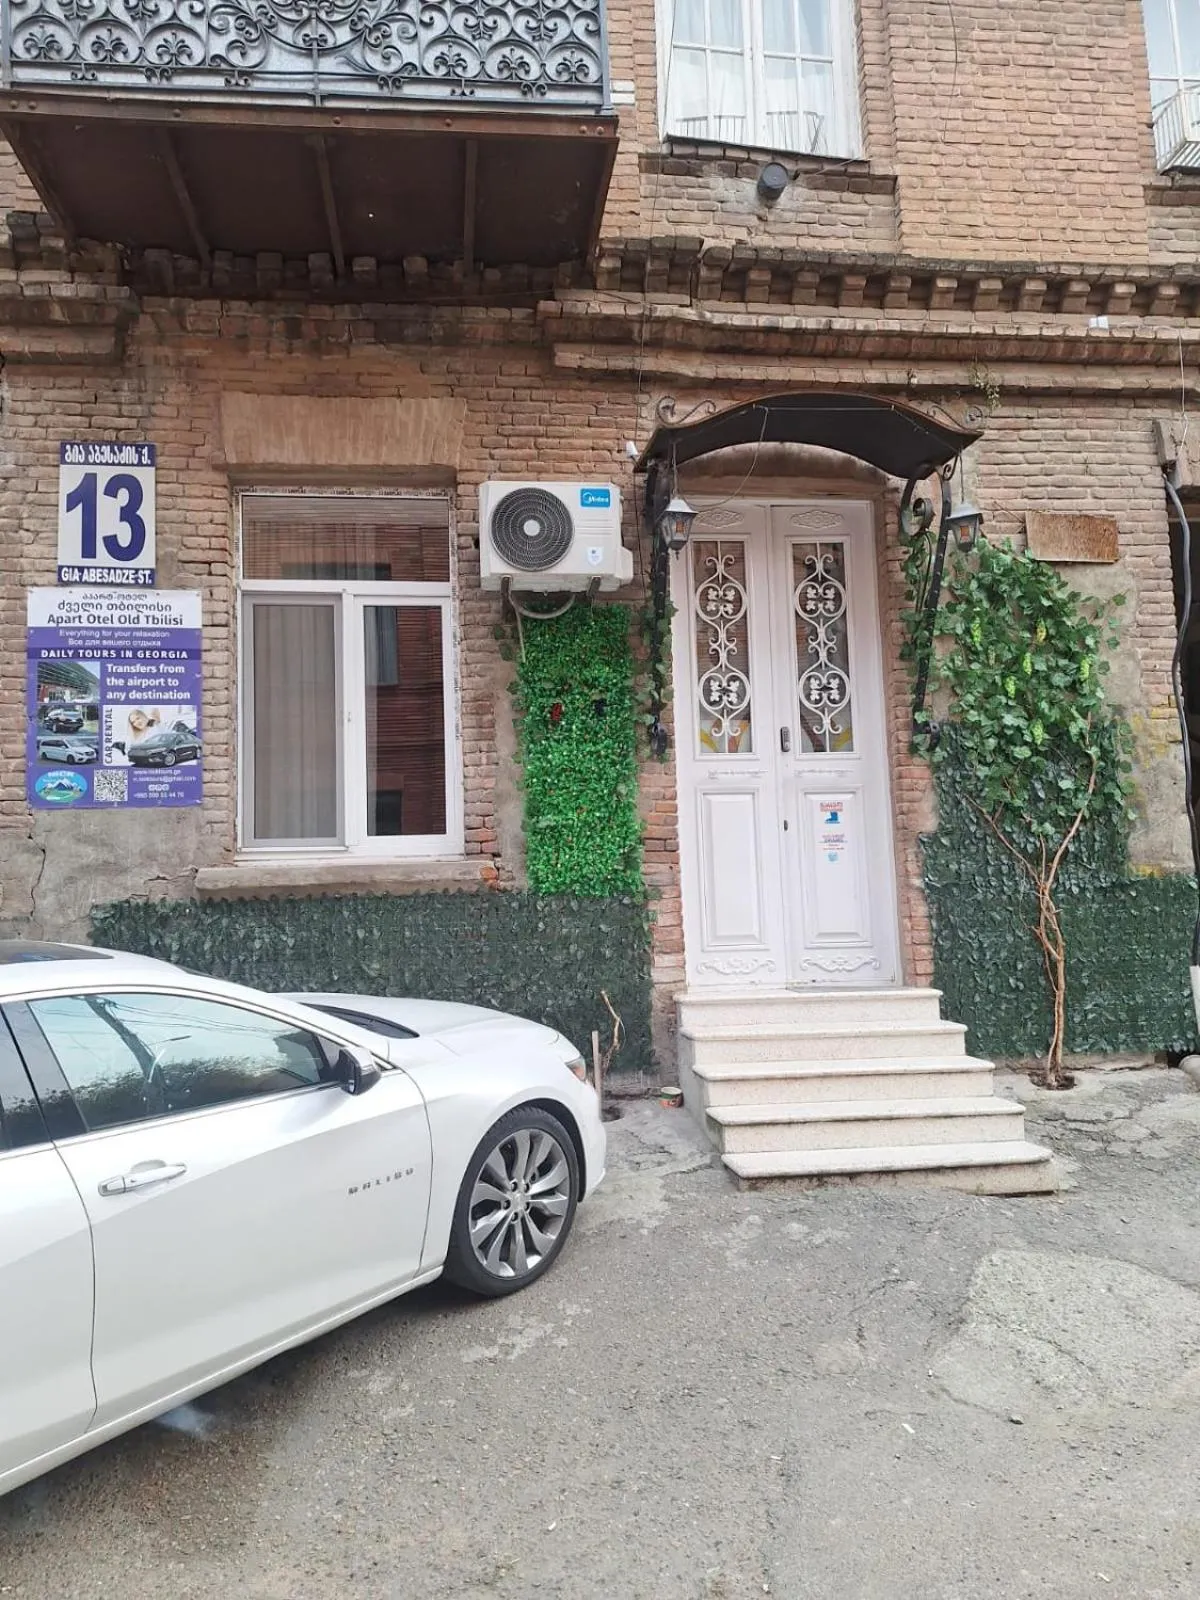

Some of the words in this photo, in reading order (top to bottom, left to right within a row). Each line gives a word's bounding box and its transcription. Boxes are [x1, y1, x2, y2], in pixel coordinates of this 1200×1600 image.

[65, 444, 85, 463] გია
[65, 472, 146, 562] 13
[61, 568, 80, 582] GIA
[83, 568, 136, 583] ABESADZE
[138, 570, 152, 584] ST.
[57, 599, 103, 613] ძველი
[106, 600, 172, 614] თბილისი
[47, 613, 82, 626] Apart
[87, 613, 114, 625] Otel
[118, 613, 140, 625] Old
[144, 614, 183, 626] Tbilisi
[59, 629, 100, 639] Everything
[101, 629, 113, 637] for
[113, 631, 131, 639] your
[132, 630, 171, 638] relaxation
[68, 638, 83, 646] Все
[41, 649, 73, 658] DAILY
[79, 650, 117, 658] TOURS
[121, 650, 133, 659] IN
[137, 650, 188, 659] GEORGIA
[106, 663, 157, 674] Transfers
[159, 664, 185, 674] from
[106, 677, 125, 687] the
[127, 677, 165, 690] airport
[167, 677, 179, 687] to
[106, 690, 126, 701] any
[128, 689, 191, 700] destination
[104, 708, 113, 744] RENTAL
[104, 744, 113, 764] CAR
